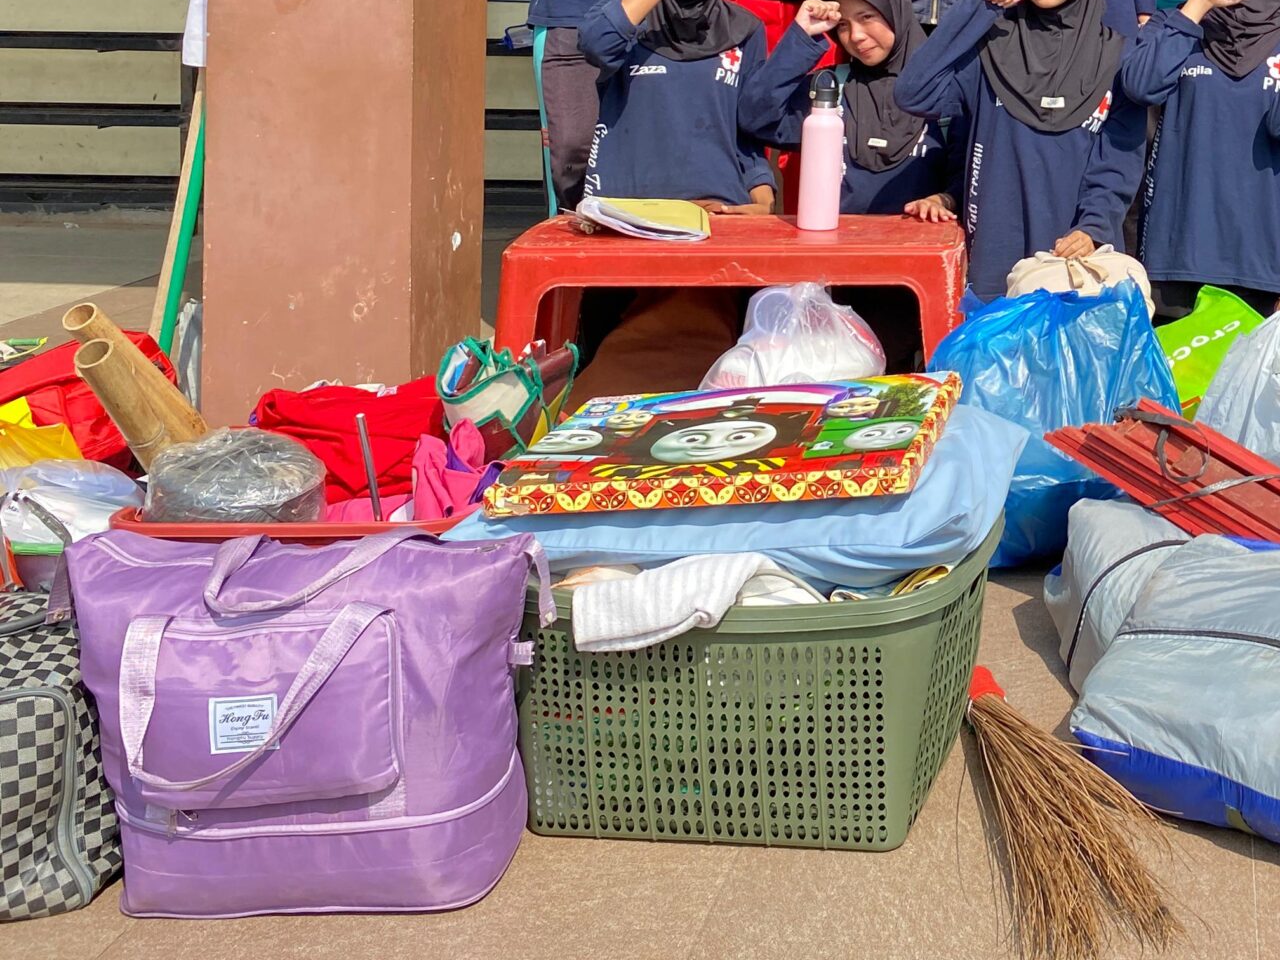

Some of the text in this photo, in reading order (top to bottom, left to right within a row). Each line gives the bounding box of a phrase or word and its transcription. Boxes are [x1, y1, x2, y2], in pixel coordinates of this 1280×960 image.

[629, 64, 667, 76] Zaza
[1181, 65, 1213, 78] Aqila
[715, 67, 739, 88] PMI
